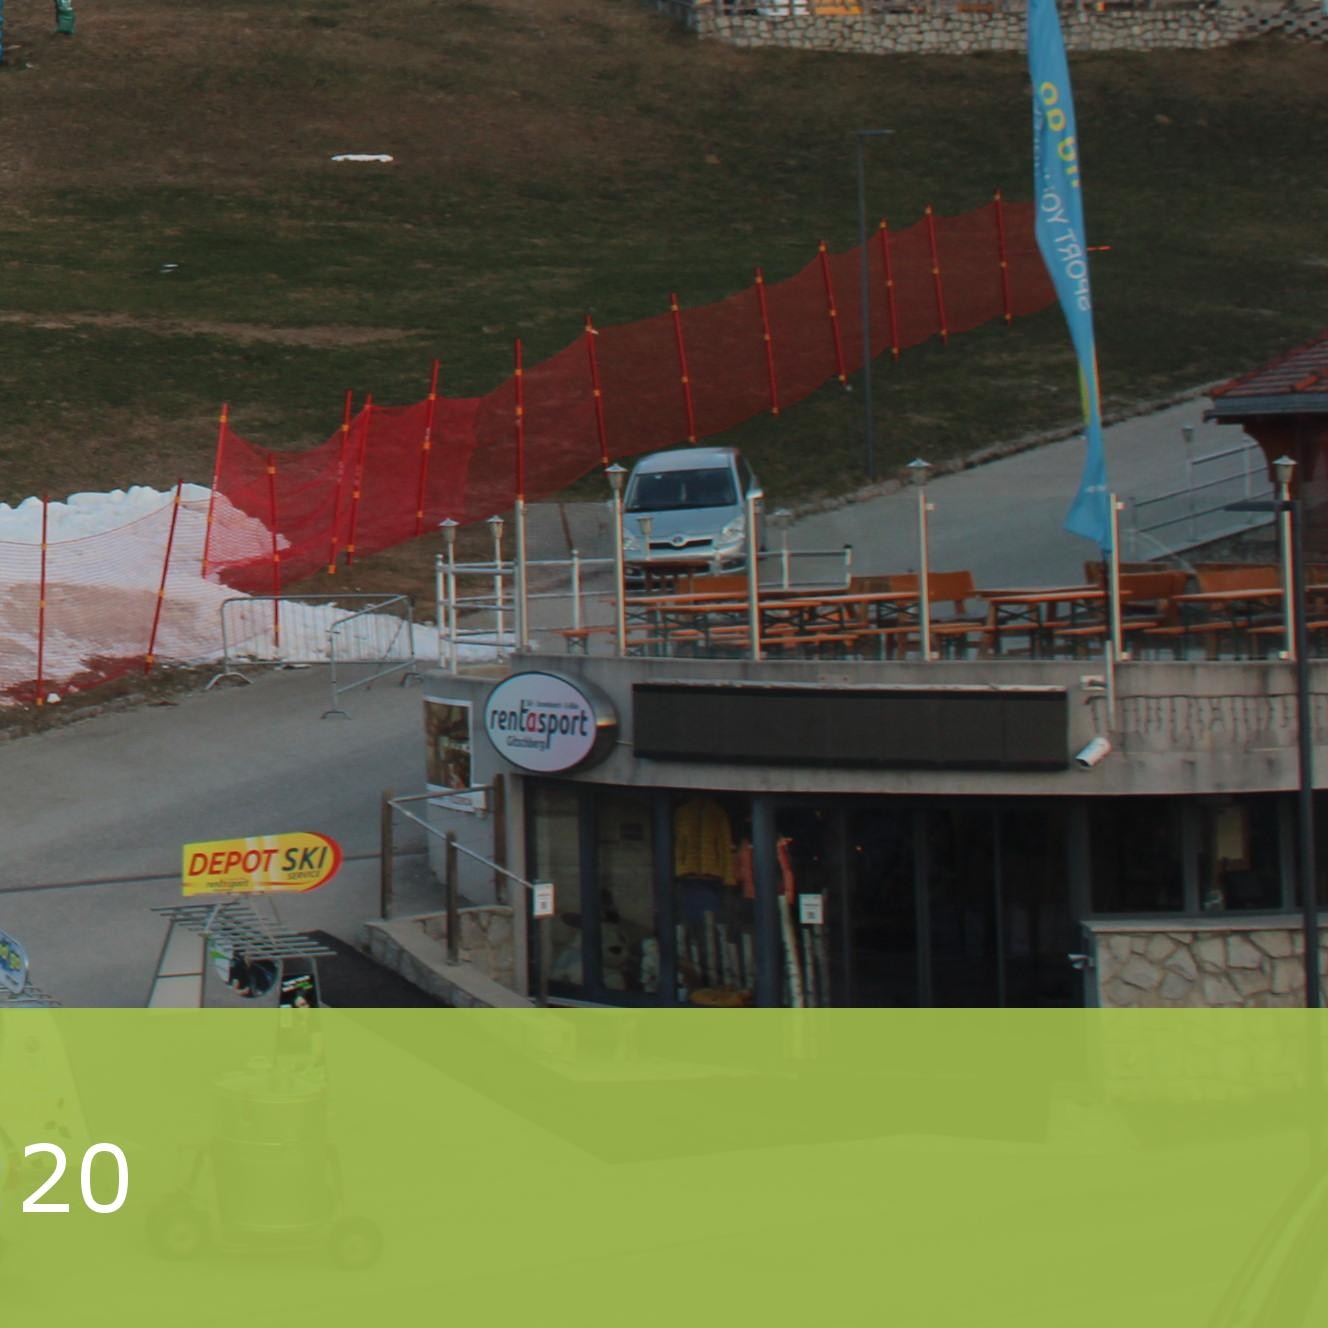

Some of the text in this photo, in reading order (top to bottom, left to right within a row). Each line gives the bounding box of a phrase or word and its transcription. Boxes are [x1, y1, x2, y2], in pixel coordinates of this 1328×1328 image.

[490, 699, 589, 749] rentasport
[188, 846, 328, 876] DEPOT SKI
